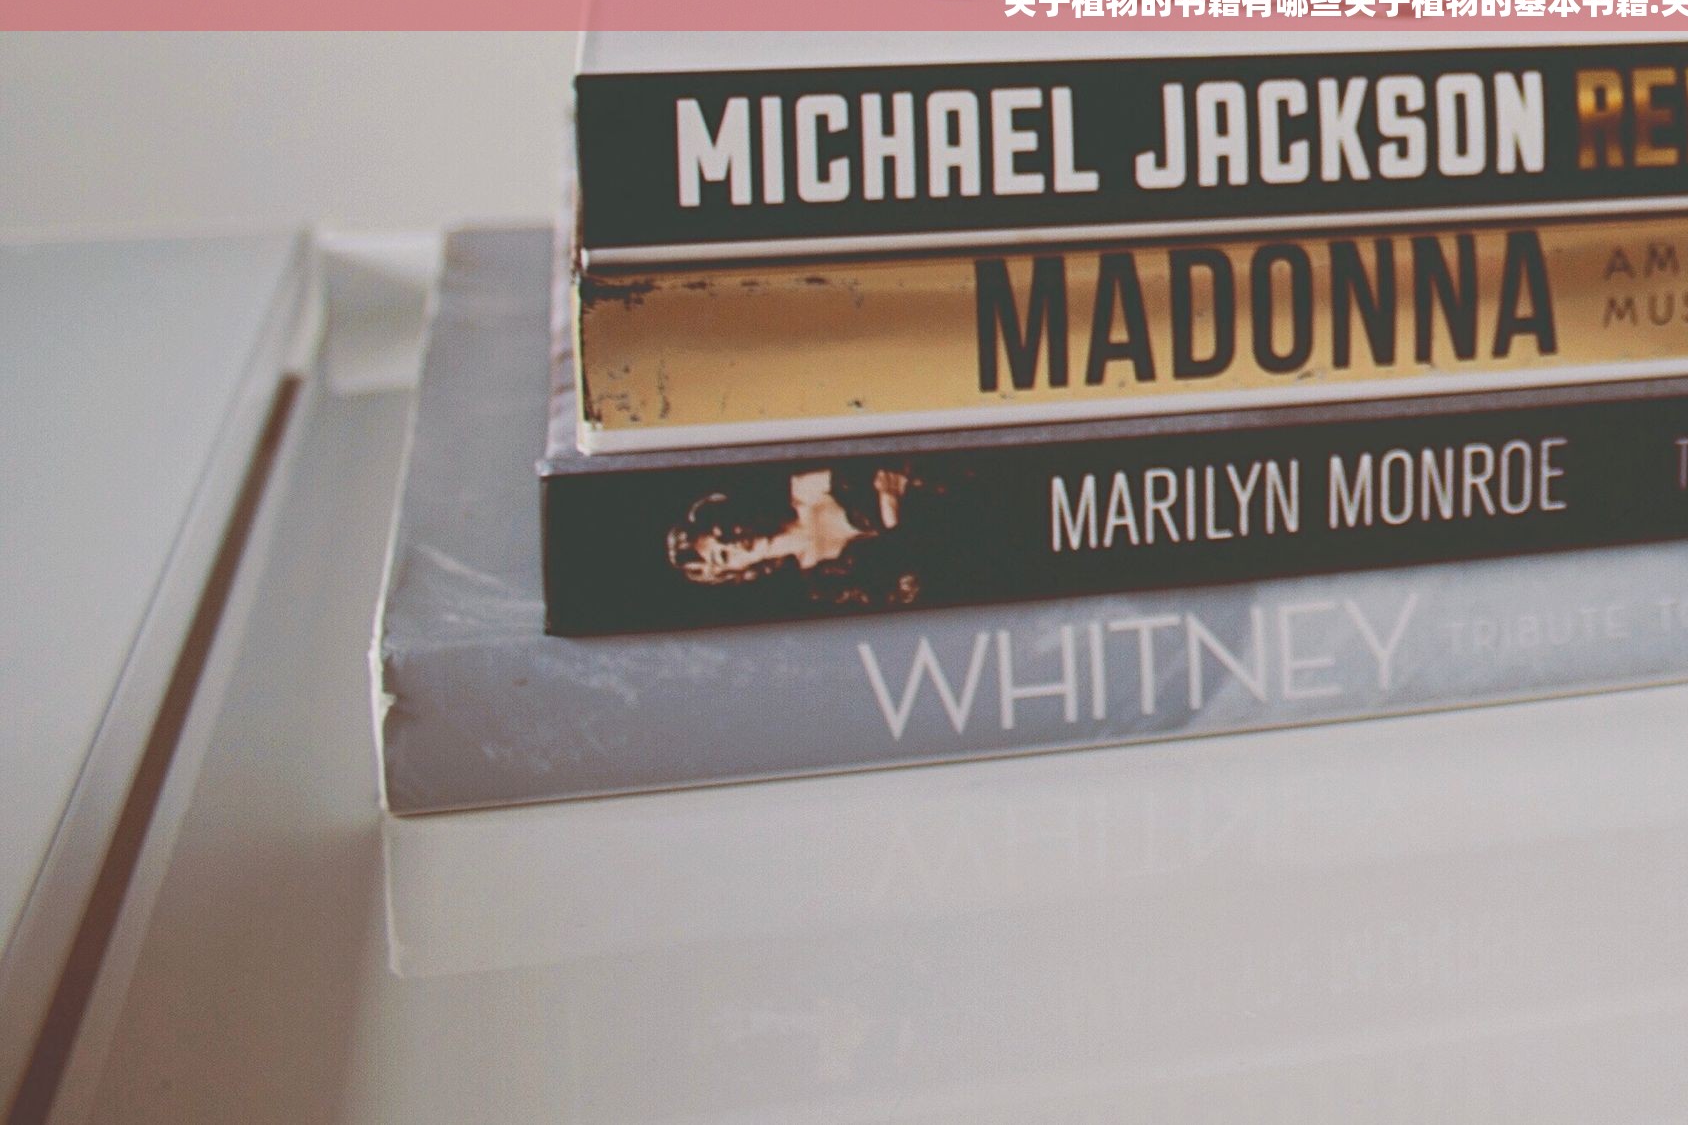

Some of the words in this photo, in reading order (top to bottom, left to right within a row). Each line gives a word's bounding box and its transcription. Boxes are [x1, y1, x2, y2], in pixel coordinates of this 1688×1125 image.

[675, 86, 1100, 208] MICHAEL
[1135, 71, 1547, 190] JACKSON
[973, 229, 1559, 394] MADONNA
[1050, 459, 1300, 553] MARILYN
[1329, 437, 1569, 532] MONROE
[857, 592, 1422, 741] WHITNEY
[1446, 602, 1631, 654] TRIBUTE
